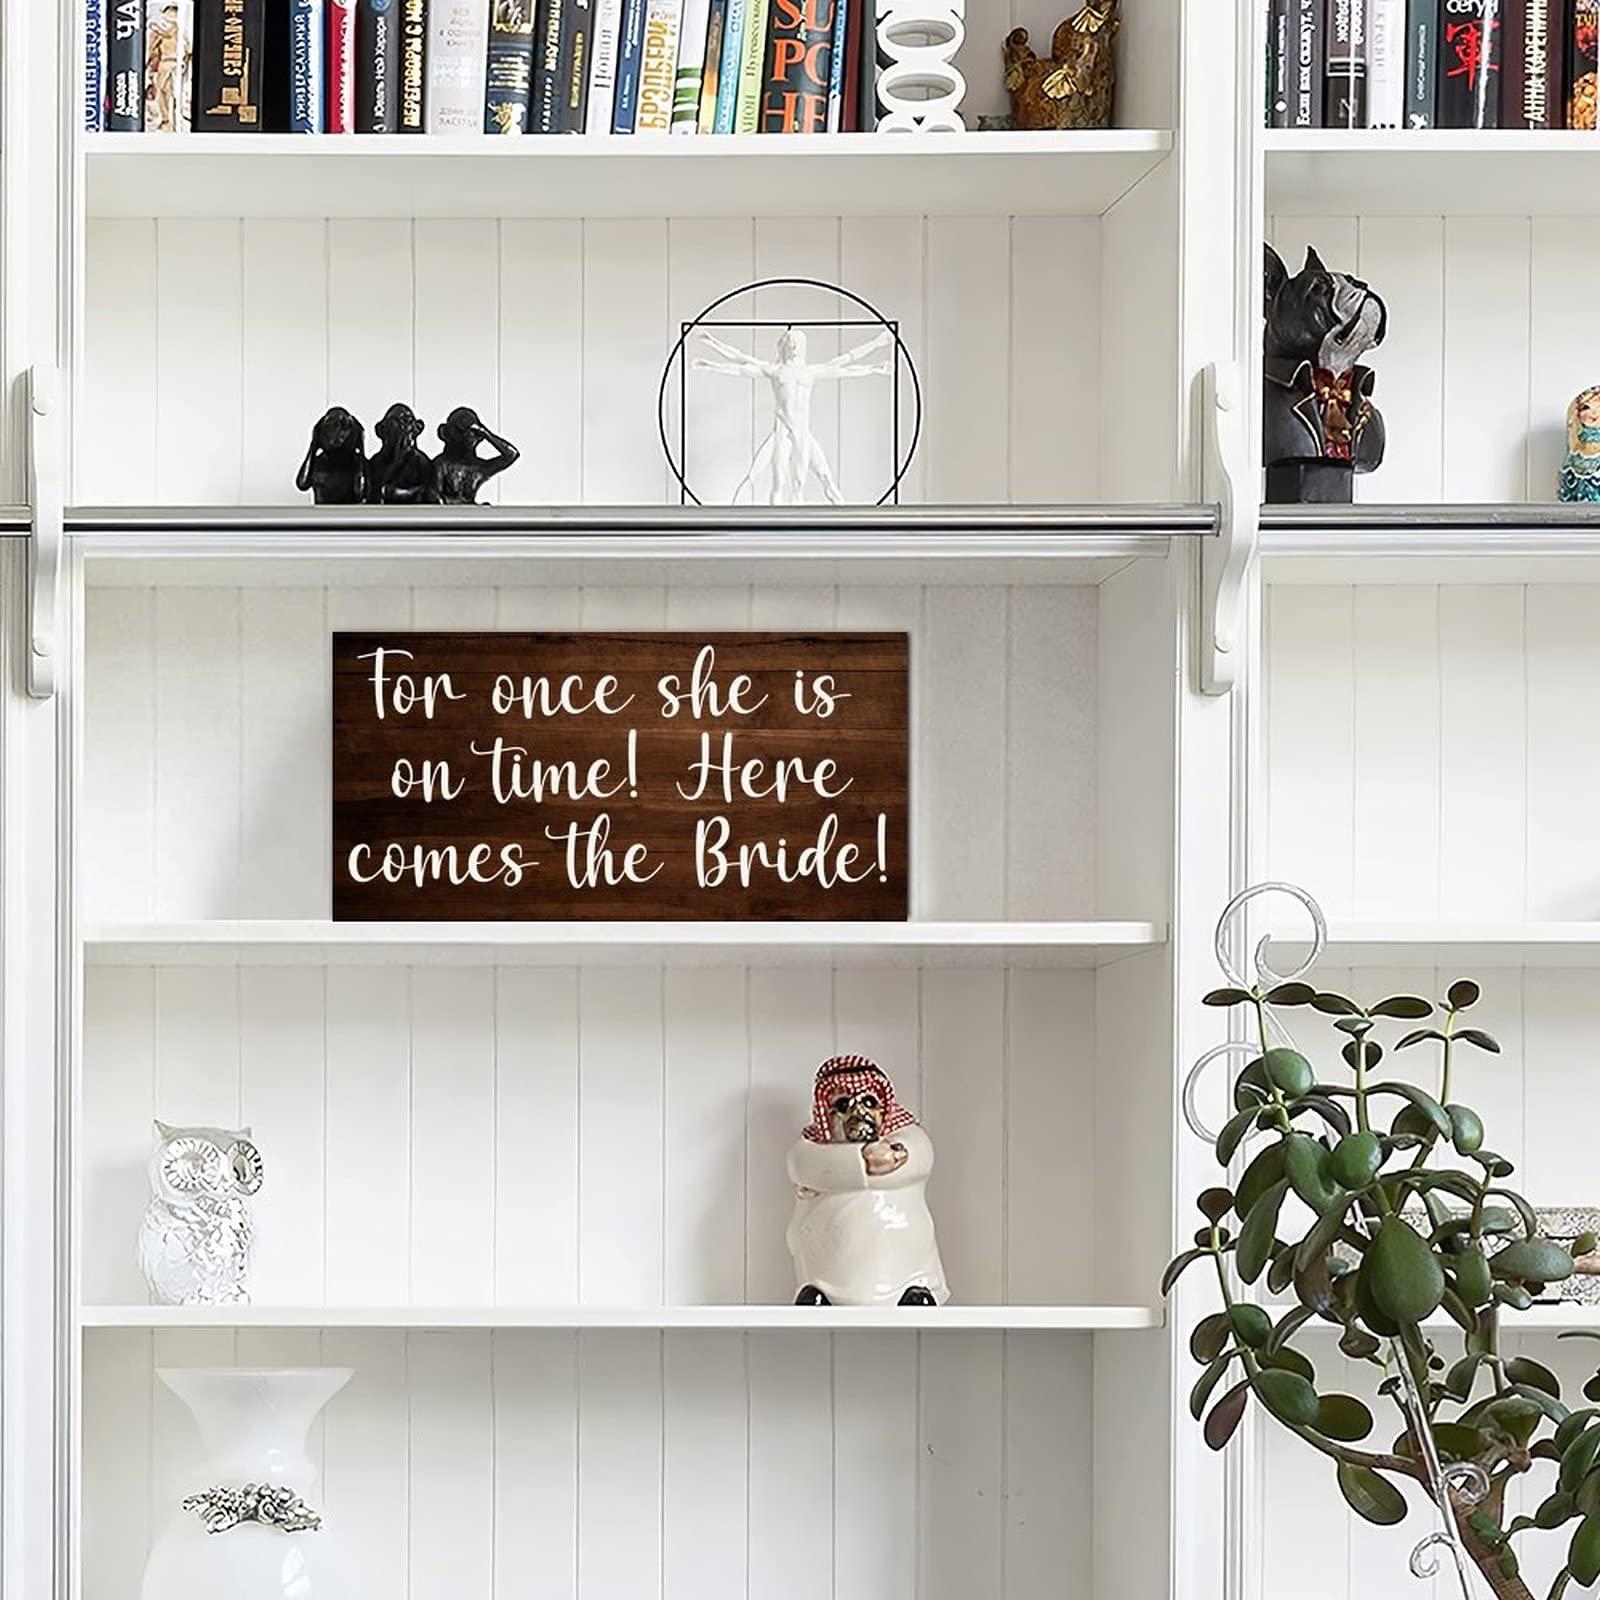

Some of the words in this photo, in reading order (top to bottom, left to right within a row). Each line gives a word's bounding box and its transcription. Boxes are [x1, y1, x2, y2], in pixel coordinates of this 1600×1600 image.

[403, 38, 423, 127] ПЕРЕГОВОРЫ
[357, 645, 466, 720] For
[492, 673, 635, 719] once
[657, 644, 769, 719] she
[794, 669, 852, 719] is
[390, 757, 465, 803] on
[470, 728, 639, 804] time!
[676, 731, 854, 804] Here
[347, 842, 540, 888] comes
[545, 812, 665, 889] the
[697, 812, 889, 889] Bride!
